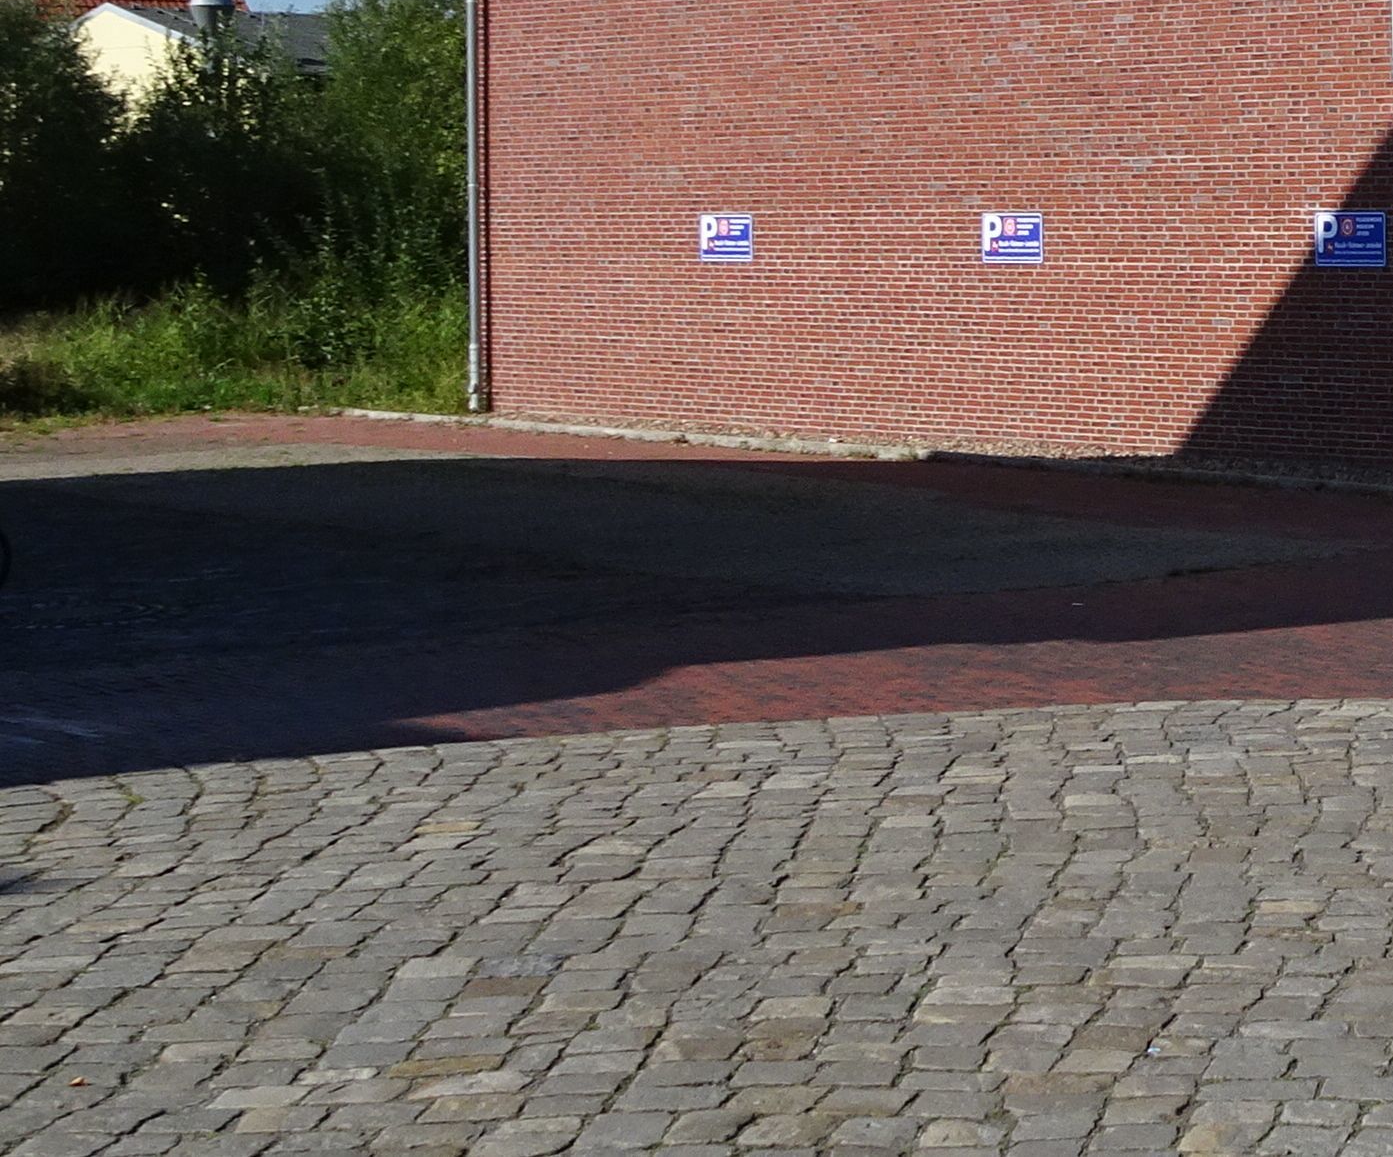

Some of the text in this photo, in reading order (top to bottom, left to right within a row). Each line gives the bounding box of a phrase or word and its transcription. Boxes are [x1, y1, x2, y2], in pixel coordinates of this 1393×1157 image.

[701, 215, 717, 250] P
[984, 215, 1002, 251] P
[1318, 215, 1338, 253] P
